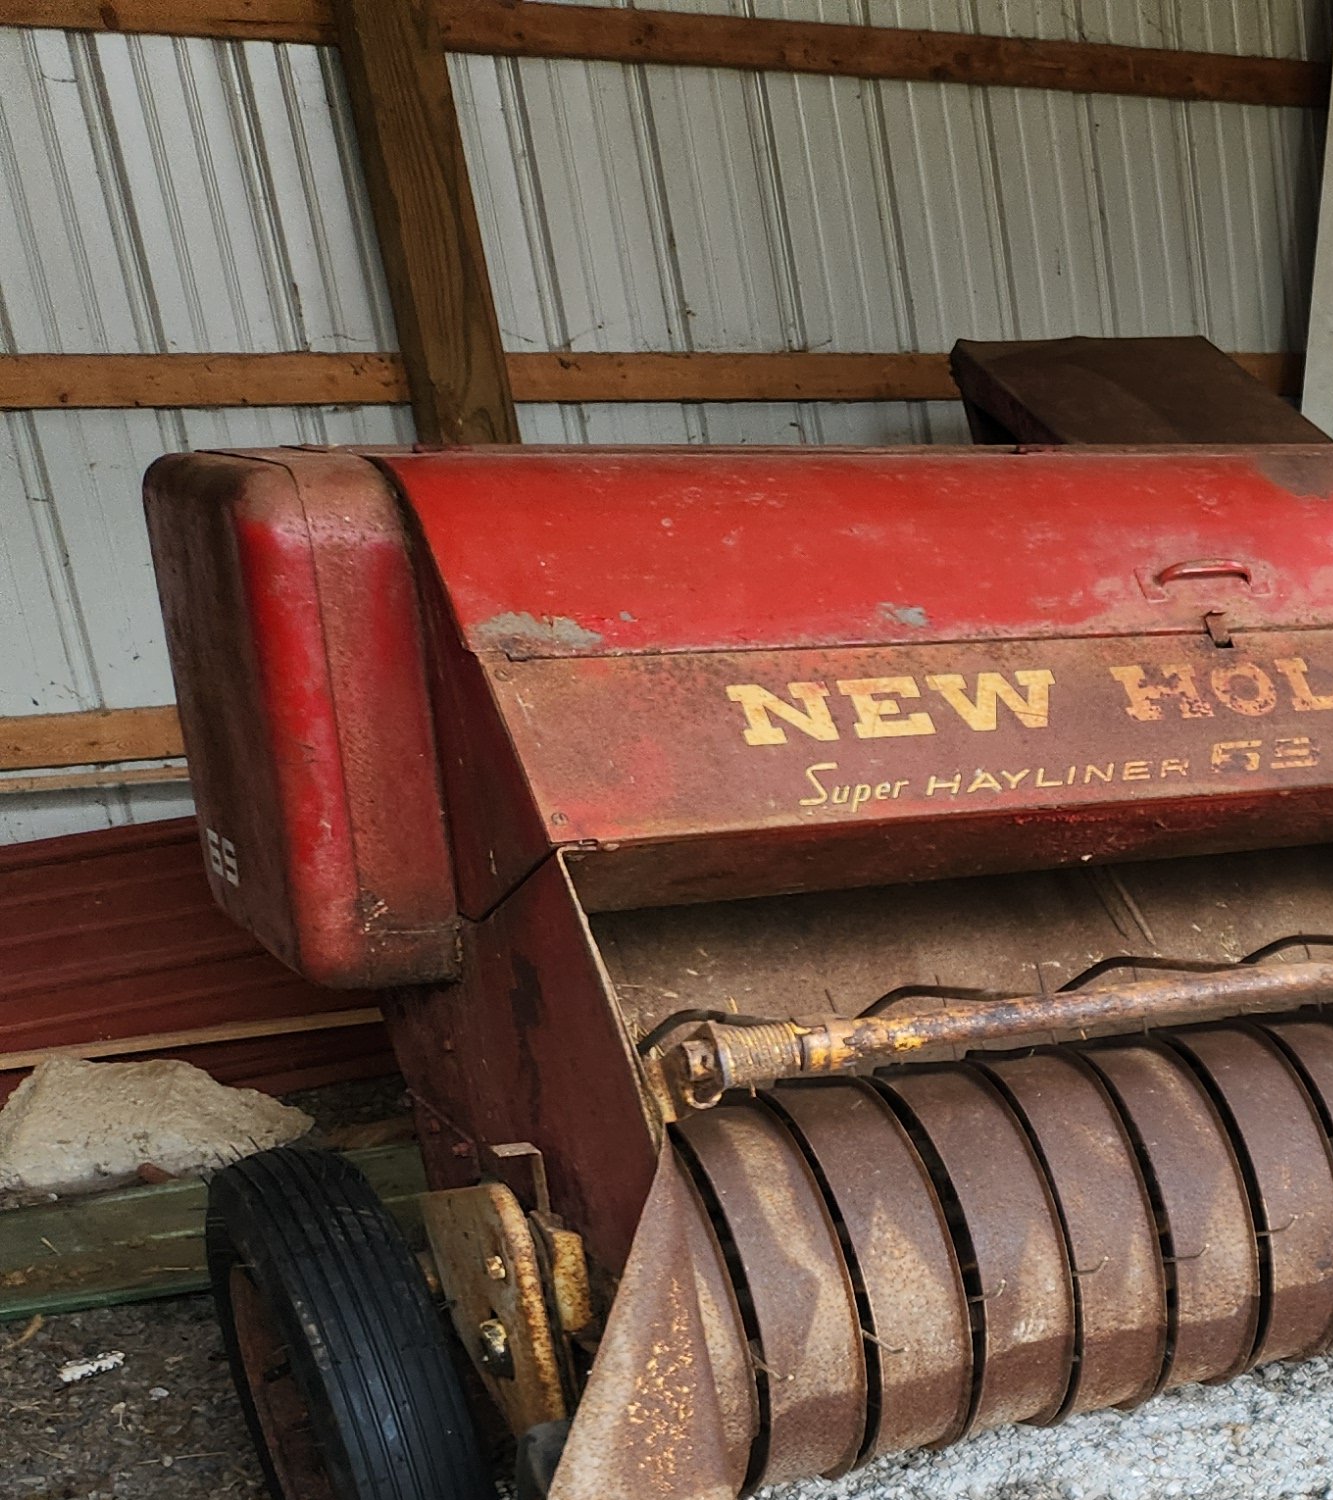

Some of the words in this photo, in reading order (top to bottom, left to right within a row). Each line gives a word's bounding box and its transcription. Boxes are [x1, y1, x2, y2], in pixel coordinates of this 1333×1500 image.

[725, 668, 1057, 746] NEW
[799, 761, 909, 813] Super
[925, 758, 1190, 797] HAYLINER
